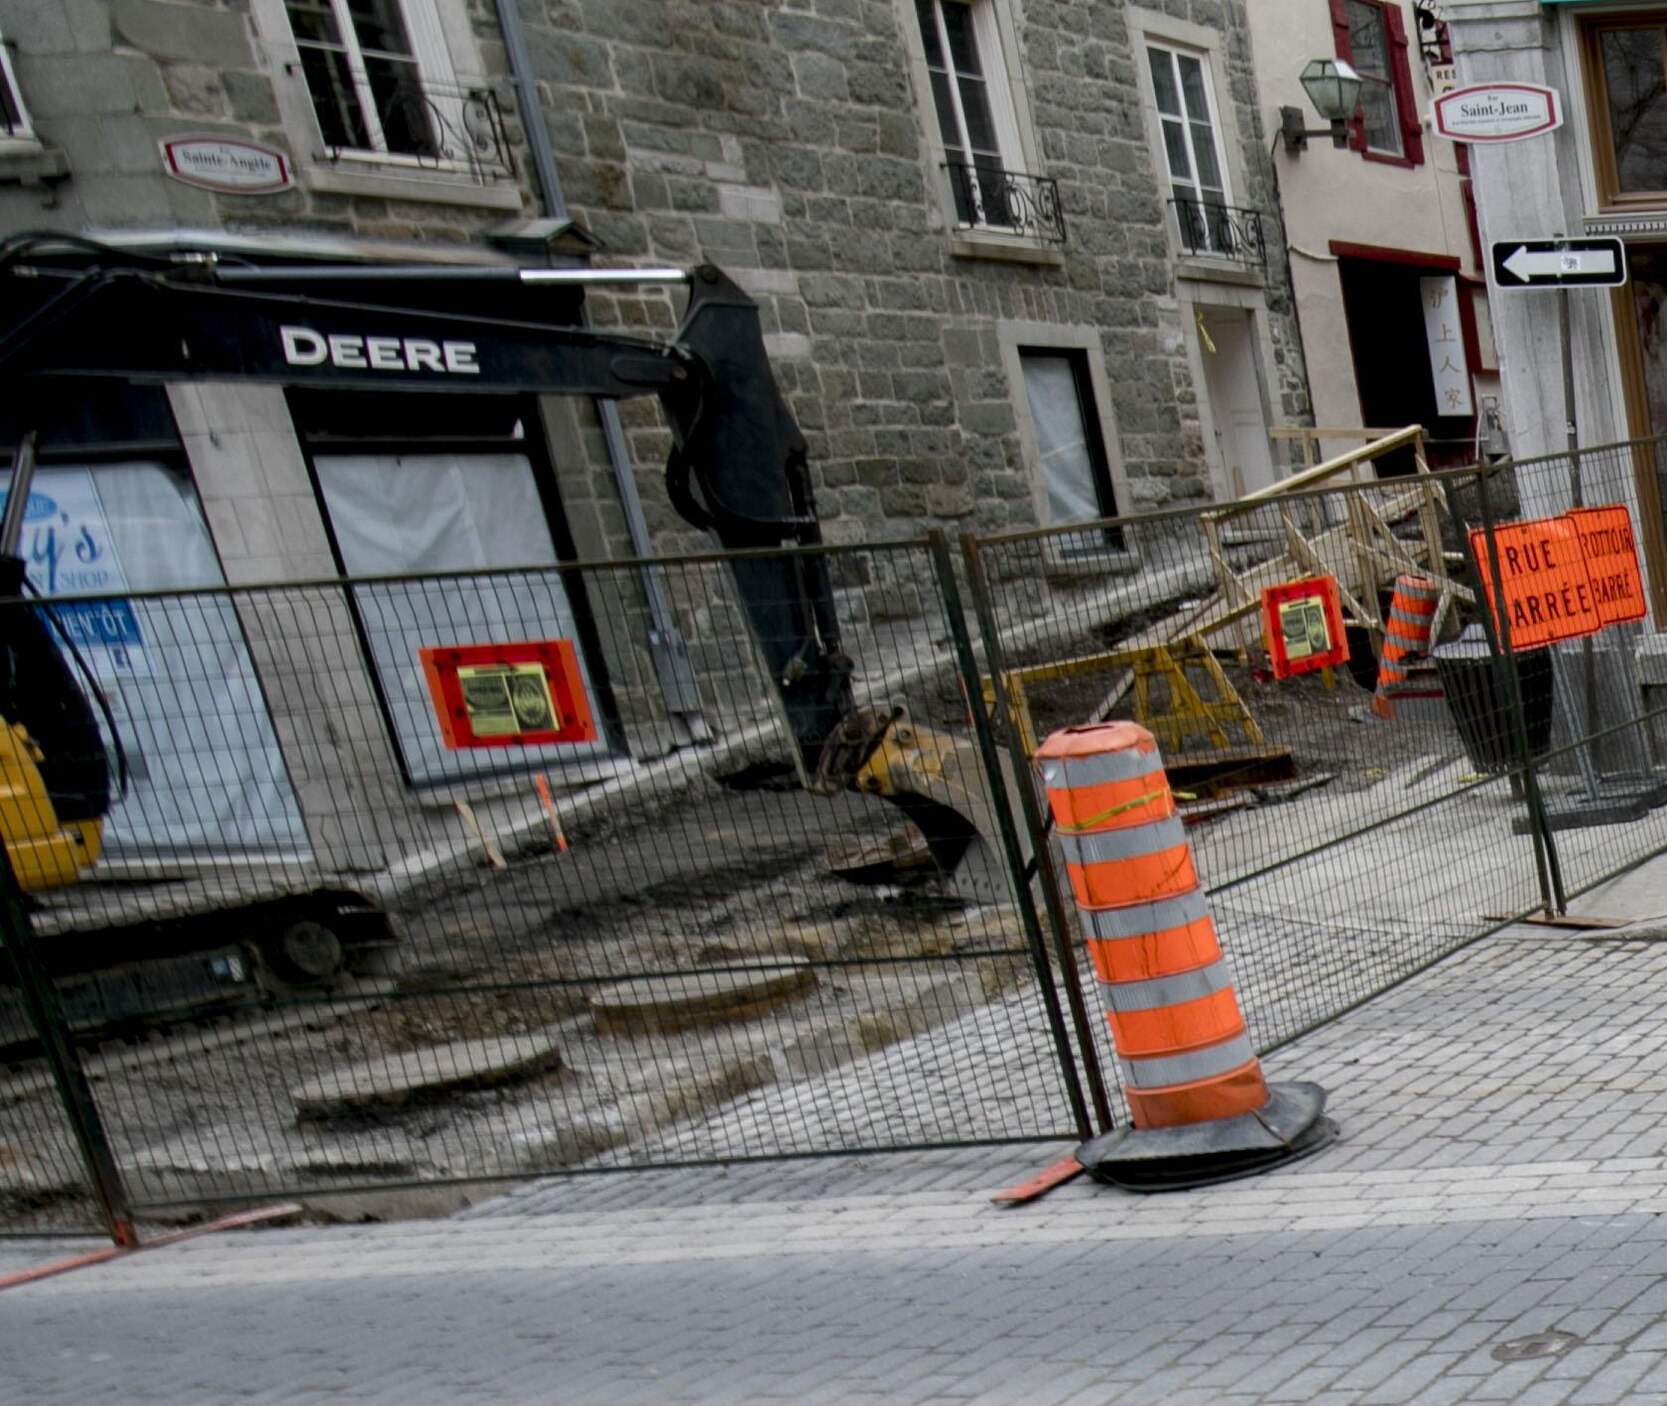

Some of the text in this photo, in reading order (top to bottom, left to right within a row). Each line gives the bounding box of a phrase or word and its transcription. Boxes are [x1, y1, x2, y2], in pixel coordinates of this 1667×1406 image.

[1460, 102, 1528, 118] Saint-Jean
[279, 325, 480, 374] DEERE
[1505, 539, 1556, 575] RUE
[1509, 582, 1591, 628] ARRÉE
